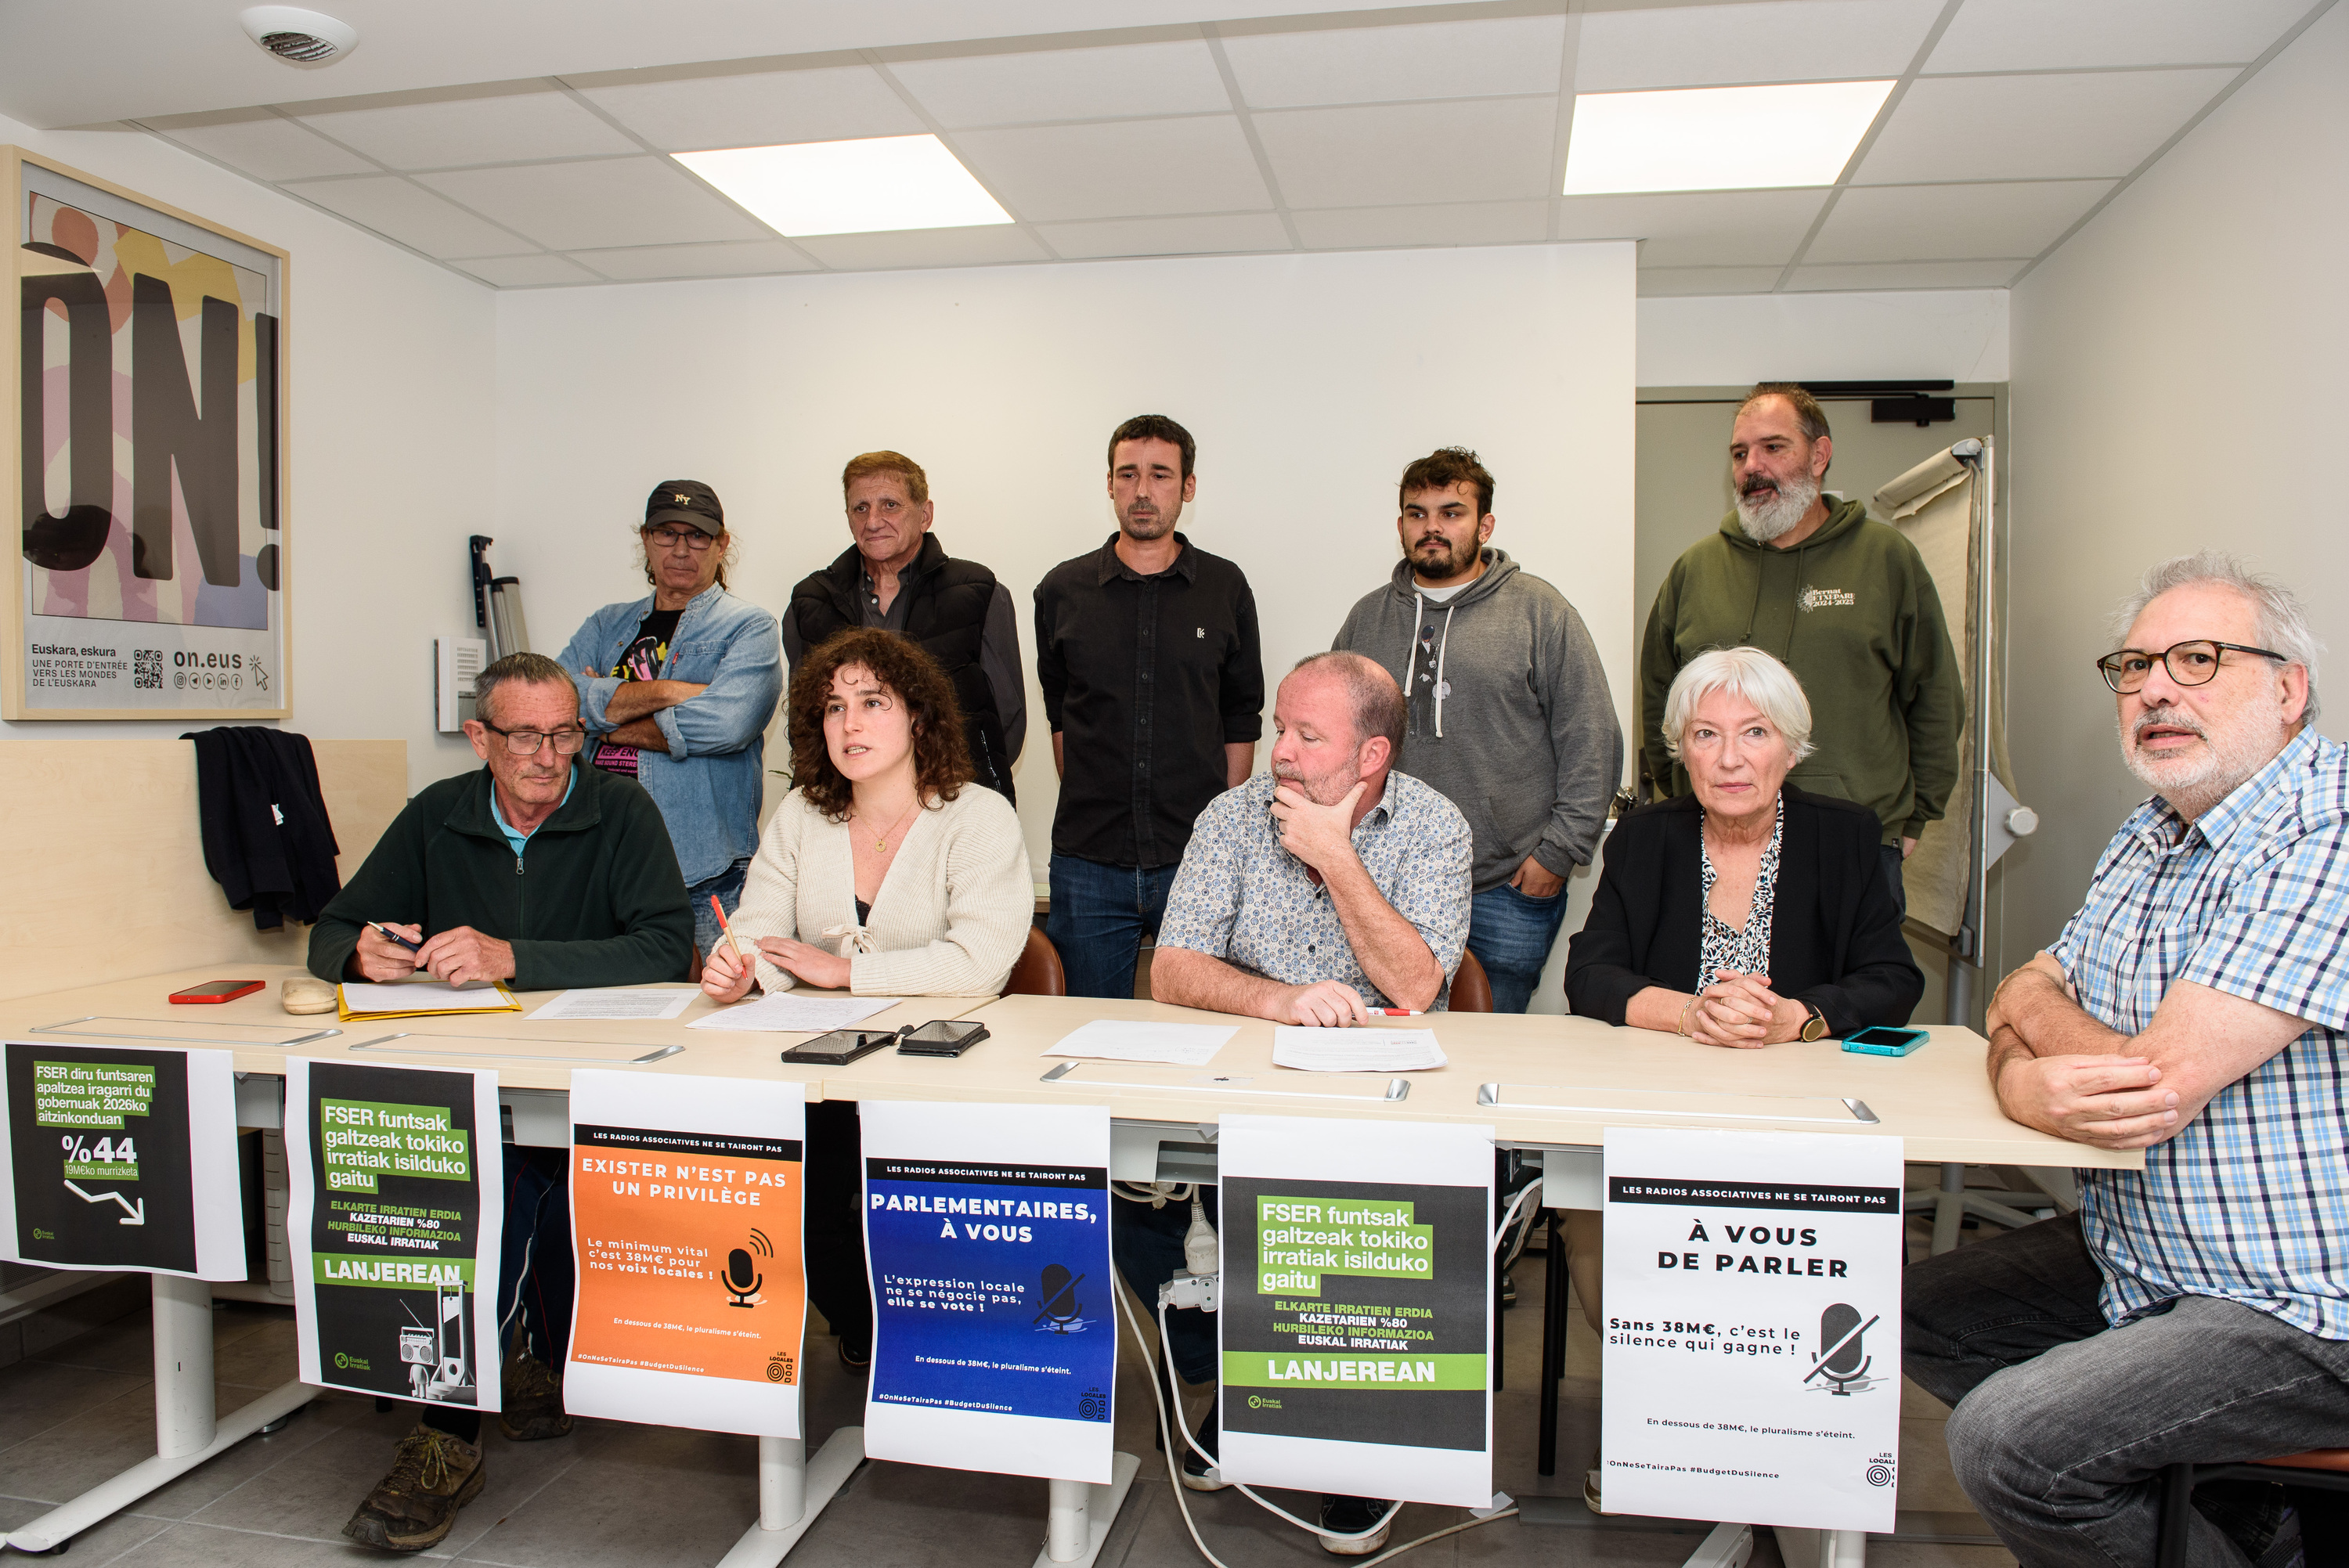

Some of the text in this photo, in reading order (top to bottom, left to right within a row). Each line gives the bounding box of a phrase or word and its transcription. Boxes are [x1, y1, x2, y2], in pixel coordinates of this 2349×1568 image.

[21, 241, 280, 592] ON!
[675, 493, 690, 505] NY
[1813, 593, 1855, 601] ETXEPARE
[1813, 599, 1854, 607] 2024-2025
[32, 644, 116, 657] Euskara, eskura
[55, 660, 84, 669] PORTE
[87, 660, 128, 670] D'ENTRÉE
[174, 651, 241, 669] on.eus
[33, 669, 57, 678] VERS
[79, 670, 117, 679] MONDES
[48, 679, 96, 687] L'EUSKARA
[600, 747, 619, 756] KEEP
[37, 1065, 153, 1083] FSER diru funtsaren
[37, 1082, 150, 1098] apaltzea iragarri du
[38, 1097, 147, 1112] gobernuak 2026ko
[38, 1112, 122, 1125] aitzinkonduan
[326, 1105, 448, 1131] FSER funtsak
[62, 1135, 137, 1164] %44
[326, 1129, 464, 1153] galtzeak tokiko
[642, 1137, 699, 1146] ASSOCIATIVES
[327, 1148, 466, 1174] irratiak isilduko
[65, 1165, 138, 1176] 19M€ko murrizketa
[330, 1170, 373, 1188] gaitu
[583, 1159, 785, 1187] EXISTER N'EST PAS
[613, 1181, 760, 1206] UN PRIVILÈGE
[1691, 1190, 1771, 1199] ASSOCIATIVES
[1811, 1194, 1860, 1202] TAIRONT
[331, 1201, 461, 1220] ELKARTE IRRATIEN ERDIA
[871, 1194, 1096, 1224] PARLEMENTAIRES,
[1263, 1203, 1409, 1227] FSER funtsak
[350, 1213, 439, 1229] KAZETARIEN %80
[940, 1218, 1032, 1242] À VOUS
[328, 1221, 460, 1242] HURBILEKO INFORMAZIOA
[1263, 1226, 1427, 1249] galtzeak tokiko
[1688, 1219, 1817, 1246] À VOUS
[348, 1233, 438, 1250] EUSKAL IRRATIAK
[588, 1238, 708, 1257] Le minimum vital
[589, 1249, 700, 1267] c'est 38M€ pour
[1263, 1247, 1428, 1271] irratiak isilduko
[1658, 1252, 1847, 1278] DE PARLER
[324, 1260, 460, 1283] LANJEREAN
[618, 1263, 648, 1274] voix
[653, 1265, 703, 1279] locales
[709, 1271, 713, 1280] !
[1263, 1270, 1315, 1291] gaitu
[884, 1274, 1024, 1292] L'expression locale
[887, 1297, 914, 1307] elle
[941, 1300, 974, 1311] vote
[980, 1303, 984, 1312] !
[929, 1289, 986, 1301] négocie
[992, 1295, 1021, 1305] pas,
[1276, 1301, 1433, 1318] ELKARTE IRRATIEN ERDIA
[1300, 1313, 1407, 1328] KAZETARIEN %80
[1610, 1318, 1800, 1340] Sans 38M€, c'est le
[663, 1323, 684, 1332] 38M€,
[695, 1326, 731, 1336] pluralisme
[733, 1330, 761, 1339] s'éteint.
[1273, 1322, 1434, 1340] HURBILEKO INFORMAZIOA
[1298, 1335, 1408, 1350] EUSKAL IRRATIAK
[1610, 1333, 1795, 1356] silence qui gagne !
[578, 1354, 704, 1372] #OnNeSeTairaPas #BudgetDuSilence
[1268, 1360, 1435, 1382] LANJEREAN
[1662, 1419, 1700, 1428] dessous
[1718, 1423, 1747, 1433] 38M€,
[1762, 1427, 1813, 1436] pluralisme
[1816, 1430, 1855, 1439] s'éteint.
[1690, 1467, 1779, 1478] #BudgetDuSilence
